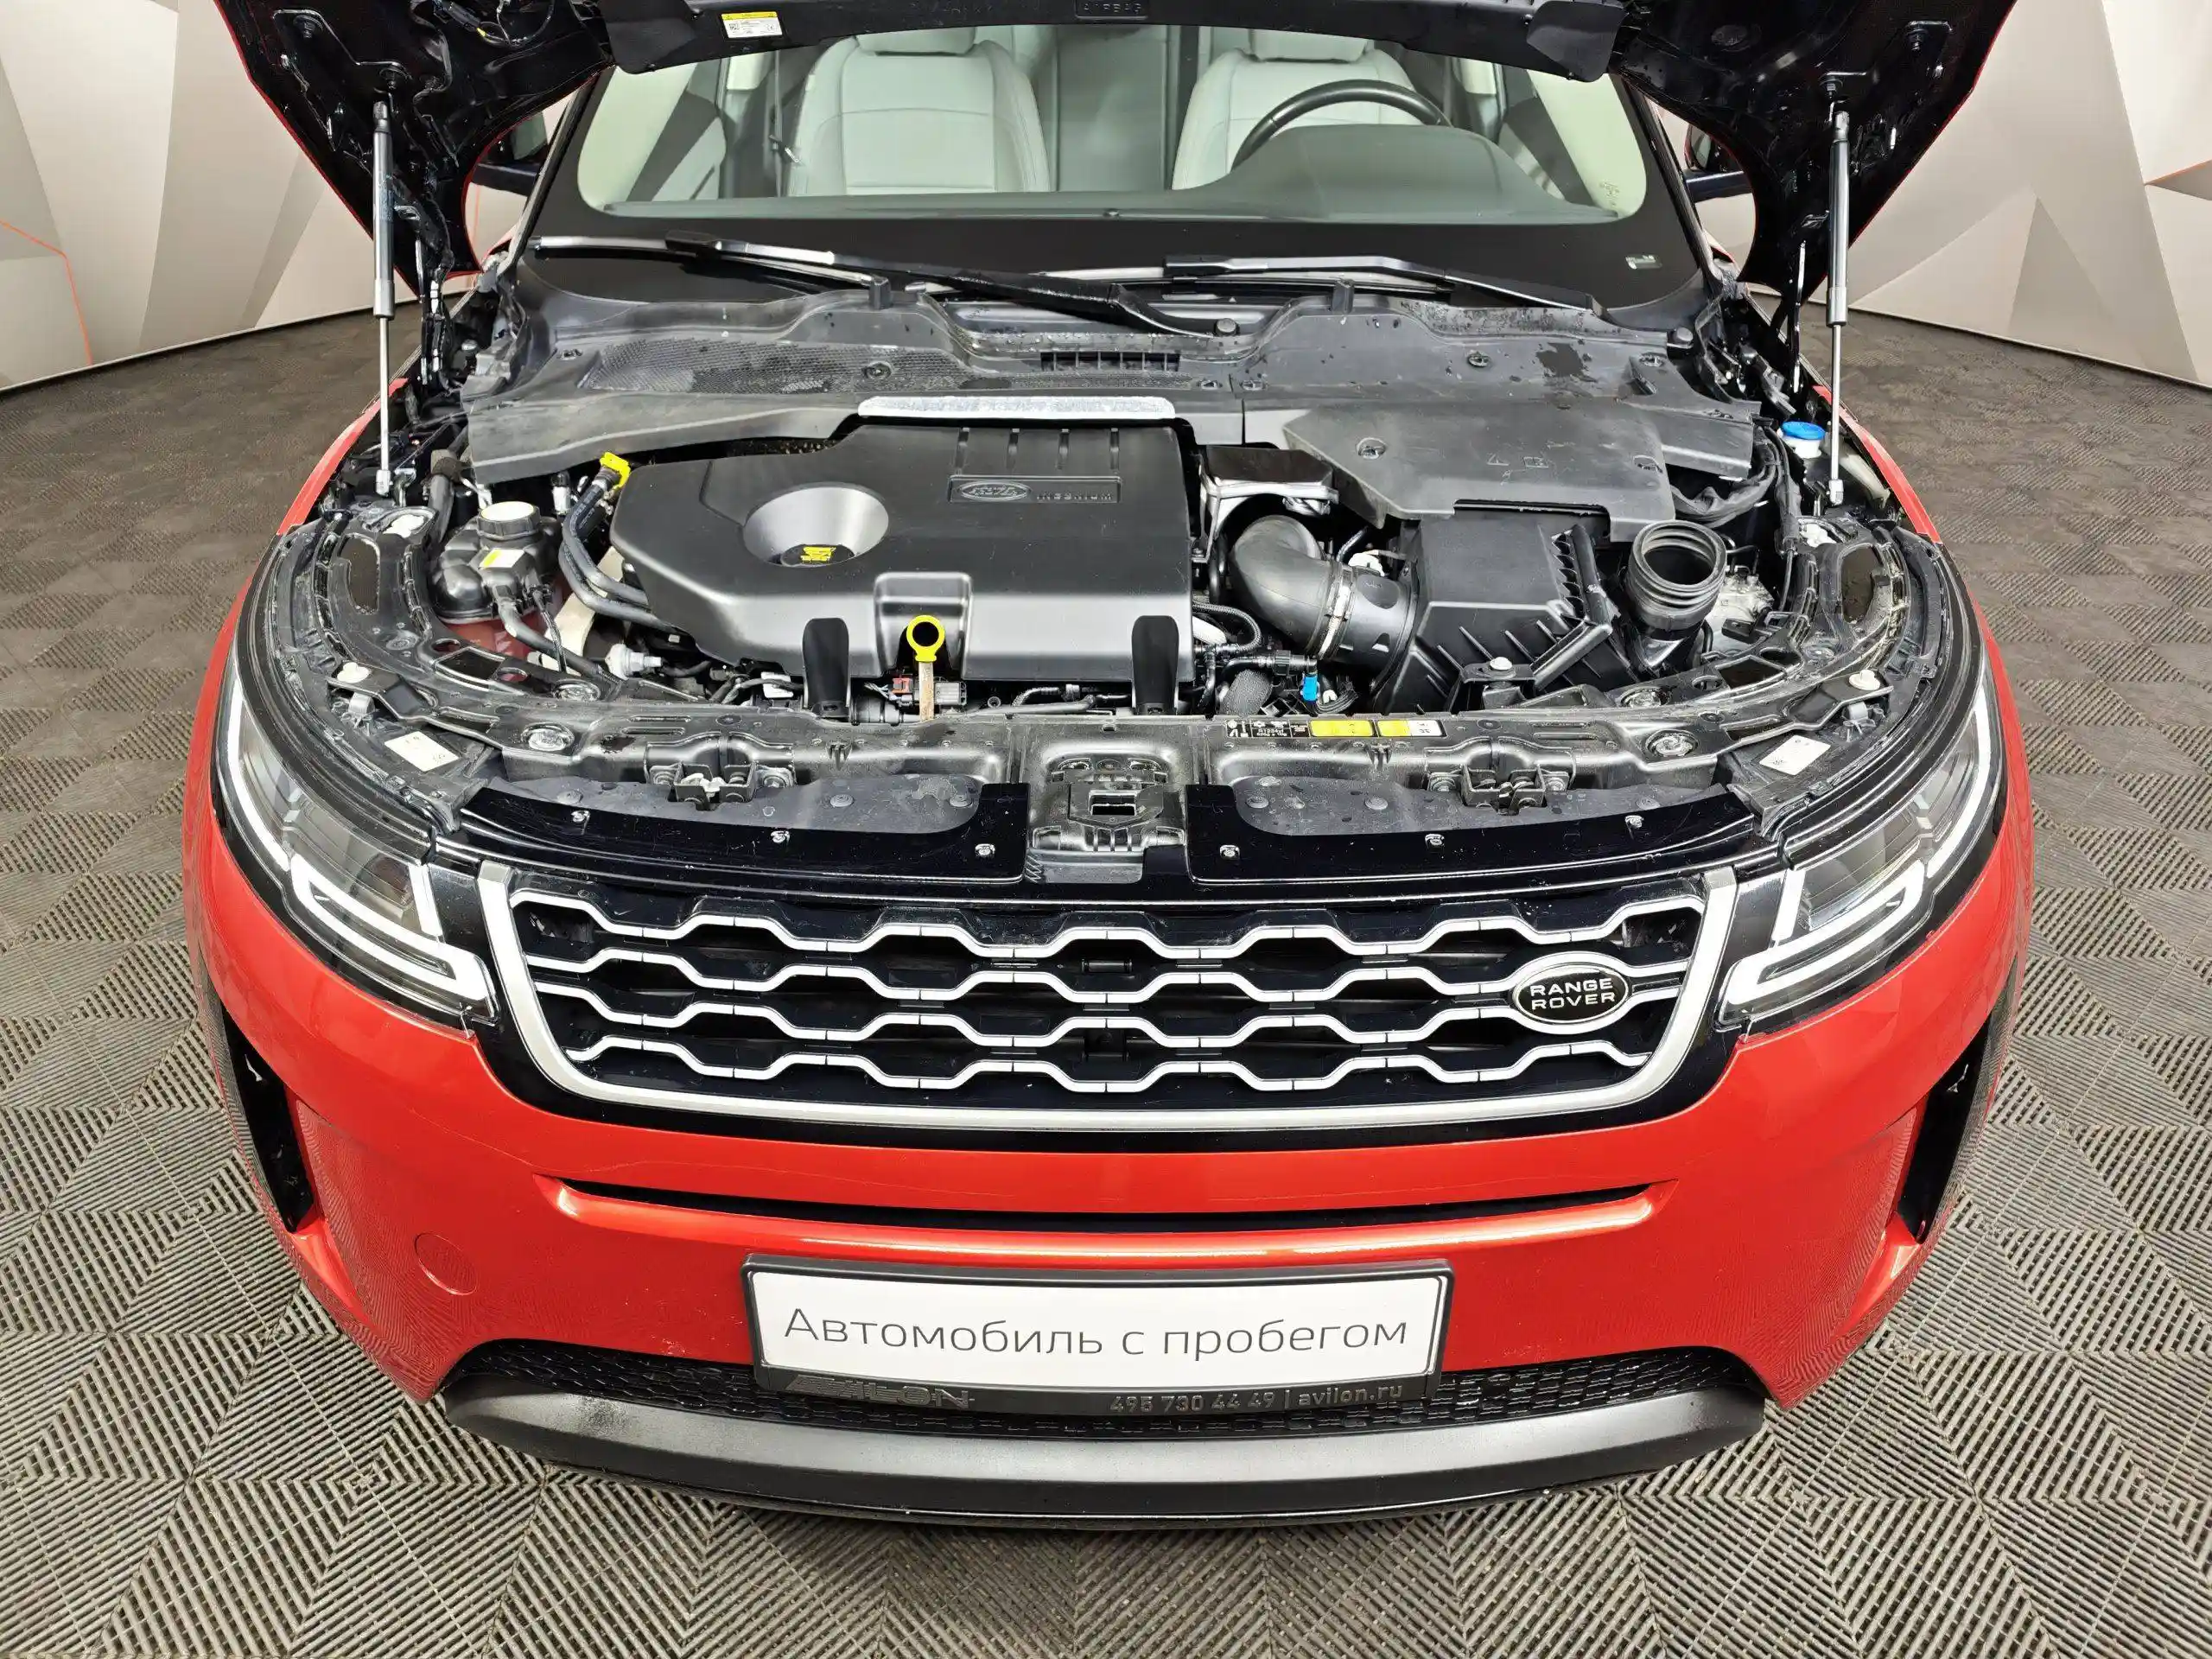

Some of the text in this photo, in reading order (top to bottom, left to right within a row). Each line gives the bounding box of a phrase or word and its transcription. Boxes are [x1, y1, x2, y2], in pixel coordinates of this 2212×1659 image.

[1529, 977, 1613, 997] RANGE
[1531, 992, 1616, 1010] ROVER
[784, 1307, 1407, 1362] Автомобиль с пробегом
[1109, 1395, 1154, 1413] 495
[1161, 1394, 1204, 1412] 730
[1298, 1384, 1402, 1405] avilon.ru
